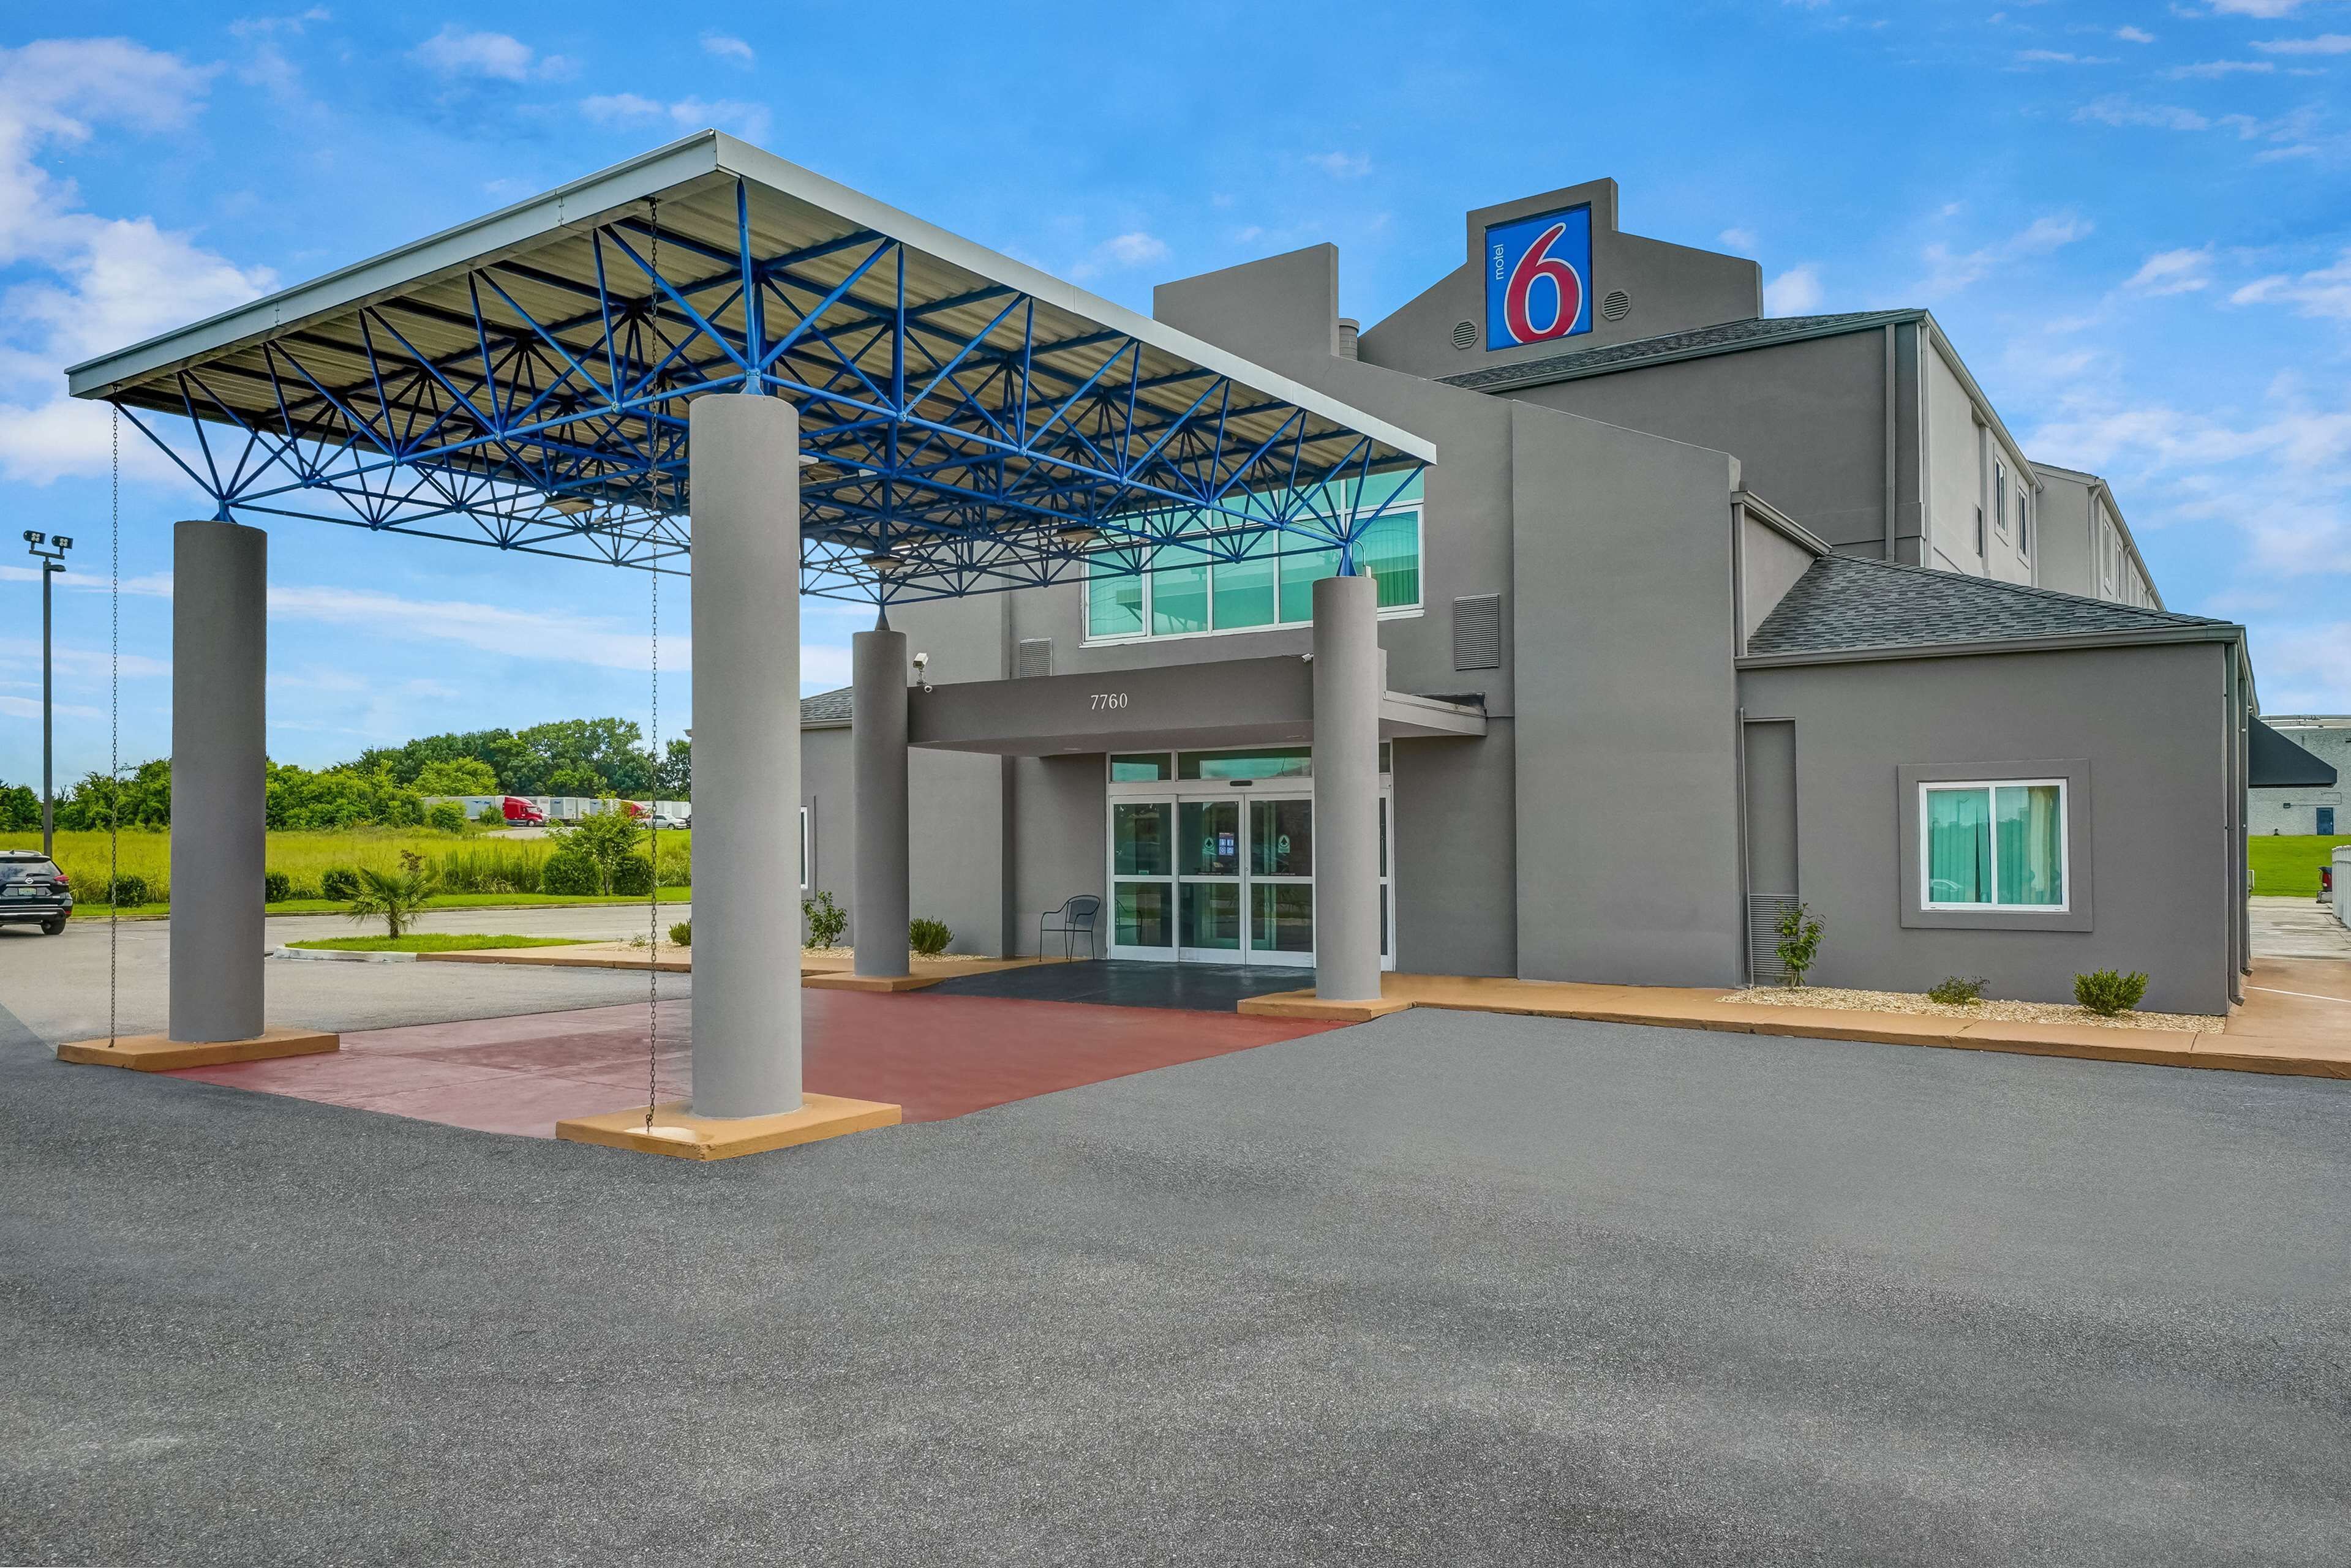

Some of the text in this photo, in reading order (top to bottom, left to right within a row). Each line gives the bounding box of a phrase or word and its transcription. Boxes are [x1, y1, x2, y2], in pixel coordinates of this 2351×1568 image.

[1494, 244, 1504, 280] motel
[1505, 222, 1582, 343] 6
[1091, 692, 1128, 710] 7760
